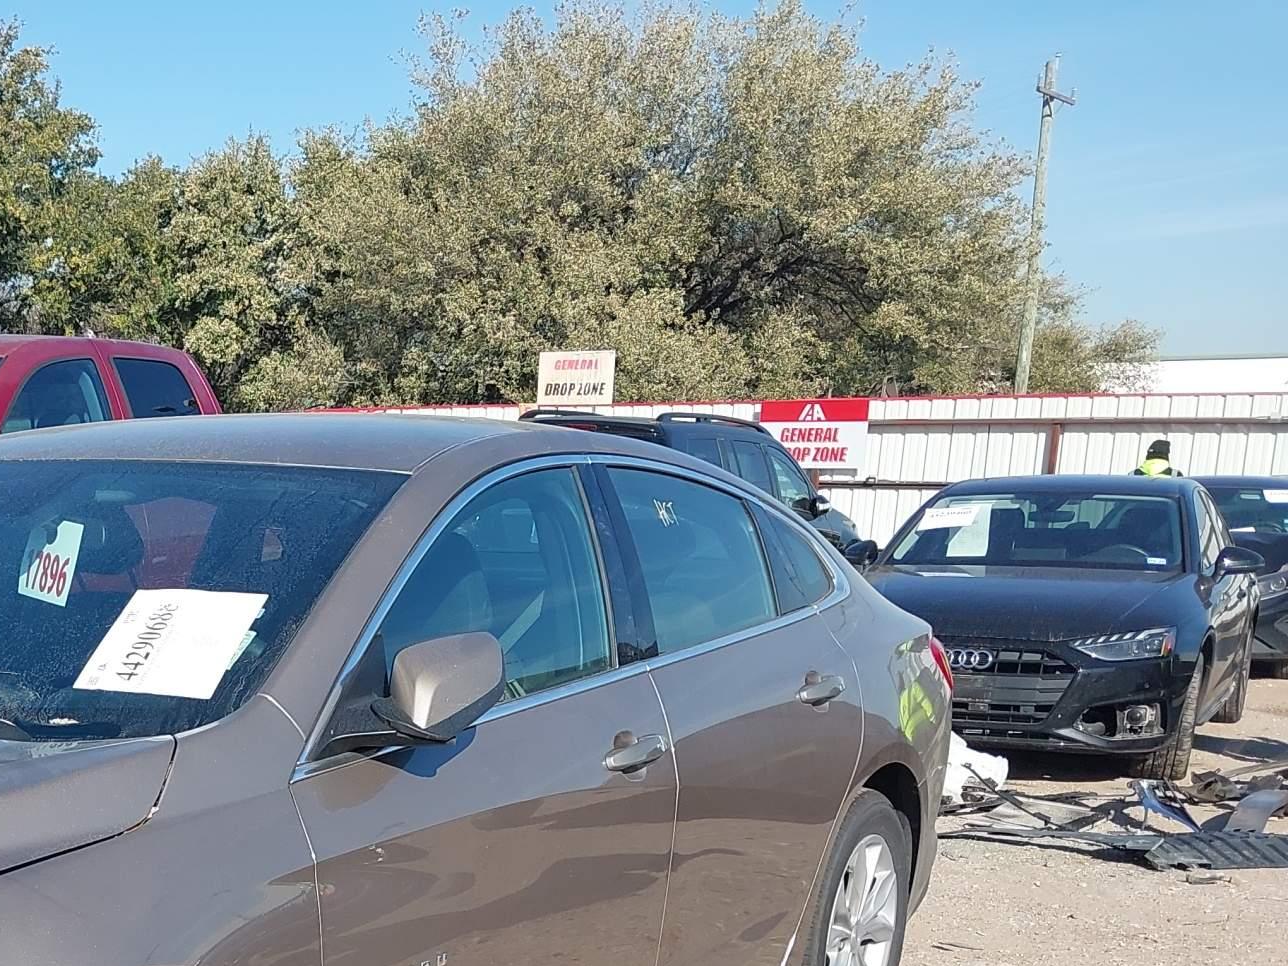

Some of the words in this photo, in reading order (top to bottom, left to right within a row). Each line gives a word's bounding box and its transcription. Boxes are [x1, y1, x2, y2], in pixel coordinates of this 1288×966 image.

[554, 359, 600, 371] GENERAL
[544, 382, 576, 396] DROP
[576, 382, 606, 396] ZONE
[780, 427, 839, 442] GENERAL
[812, 447, 848, 462] ZONE
[25, 549, 70, 598] 17896
